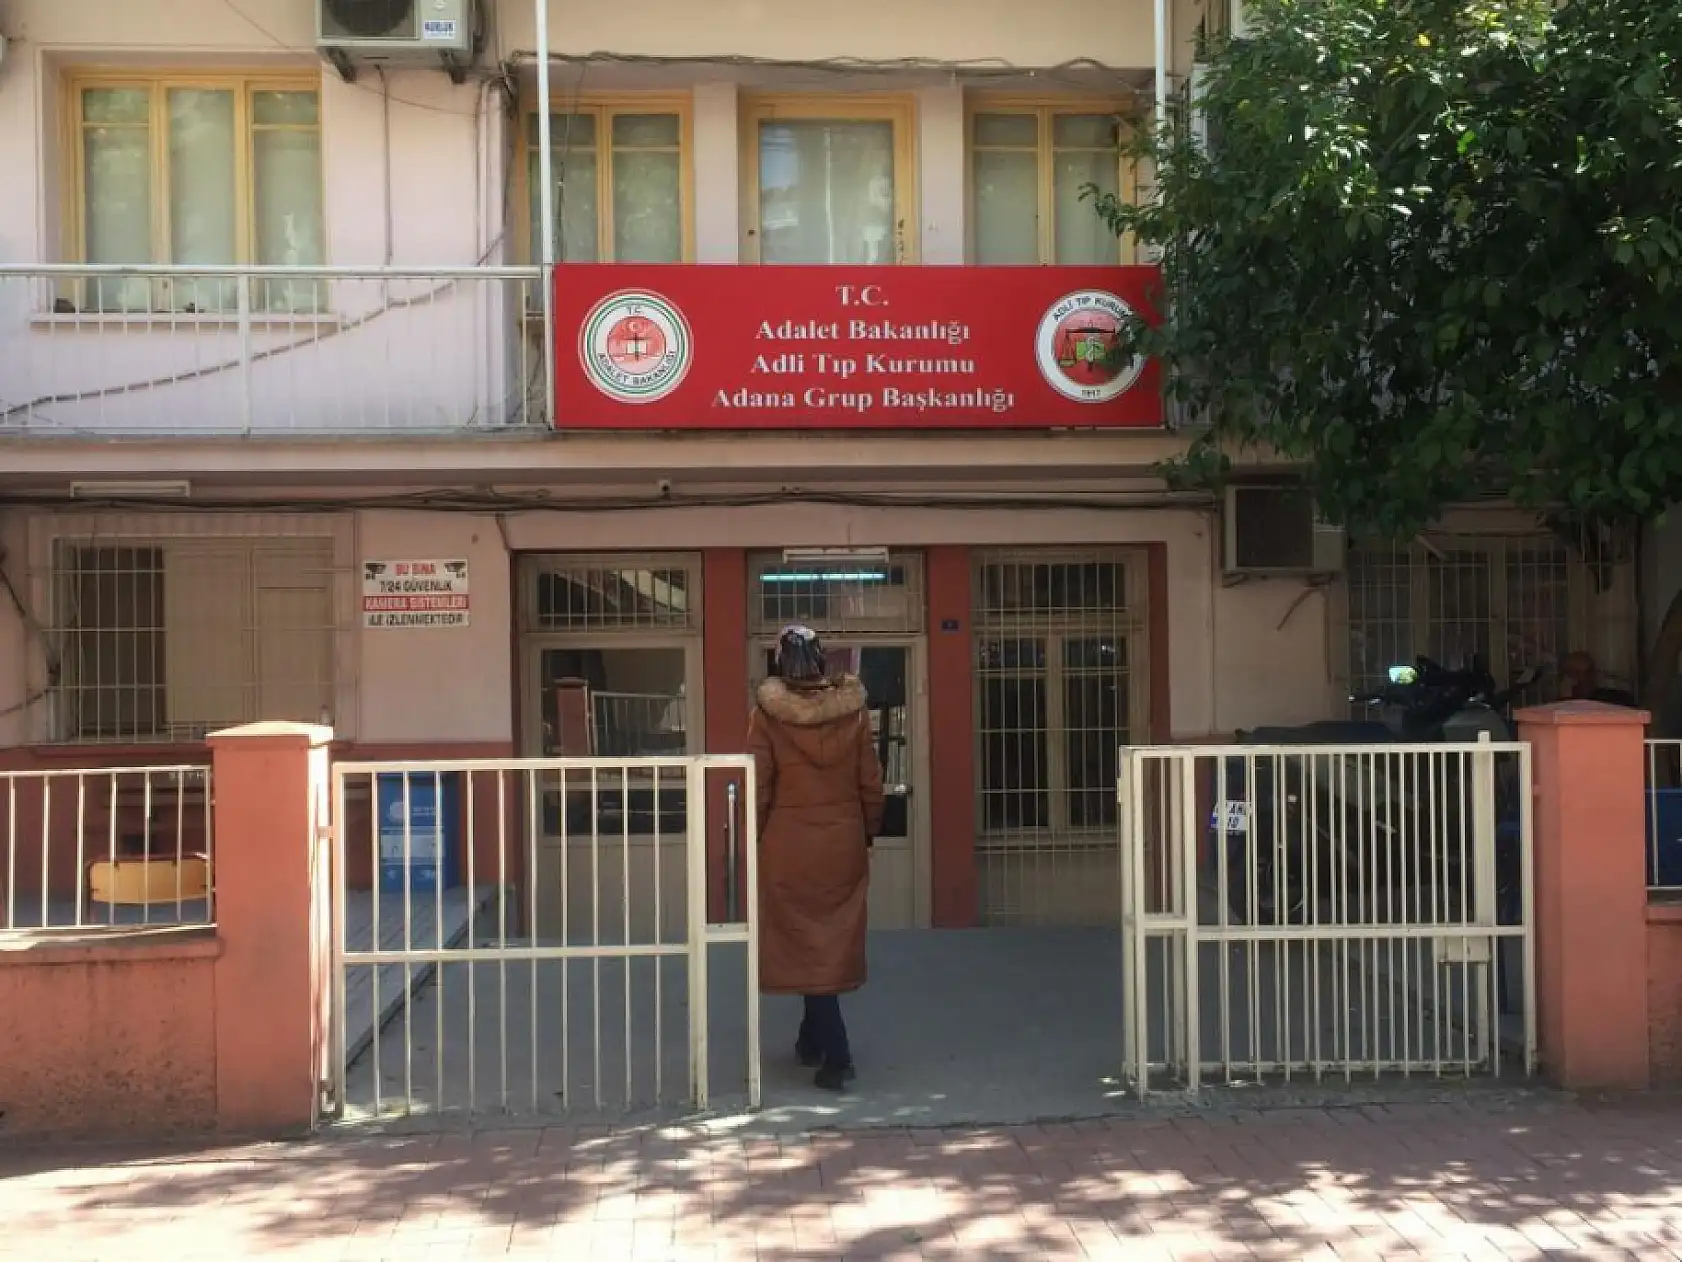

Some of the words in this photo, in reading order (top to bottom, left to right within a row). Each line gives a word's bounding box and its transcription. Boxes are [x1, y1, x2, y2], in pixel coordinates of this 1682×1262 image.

[835, 285, 889, 306] T.C.
[756, 319, 839, 340] Adalet
[849, 319, 969, 345] Bakanlığı
[751, 354, 804, 374] Adli
[811, 354, 857, 380] Tıp
[866, 354, 974, 374] Kurumu
[713, 387, 796, 408] Adana
[803, 387, 873, 412] Grup
[882, 387, 1014, 413] Başkanlığı
